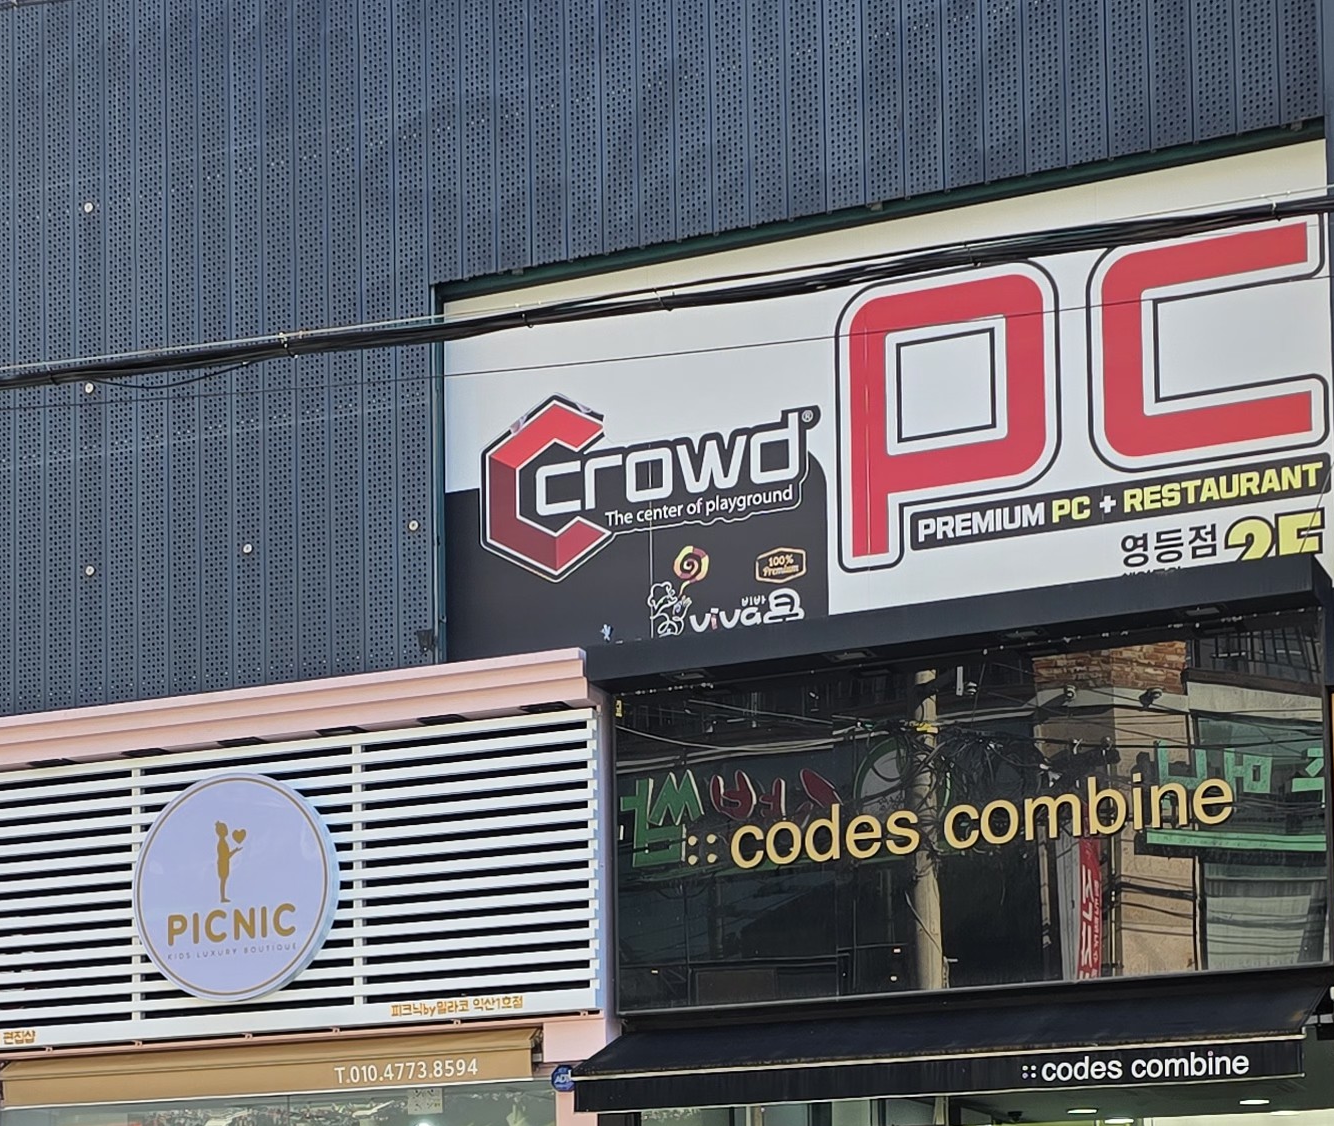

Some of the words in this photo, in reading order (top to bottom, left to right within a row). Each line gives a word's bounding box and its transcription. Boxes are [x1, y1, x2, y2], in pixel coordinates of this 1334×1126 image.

[837, 218, 1323, 568] PC
[605, 510, 633, 527] The
[635, 505, 685, 523] center
[686, 500, 704, 516] of
[705, 484, 794, 513] playground
[917, 501, 1045, 542] PREMIUM
[1051, 494, 1091, 524] PC
[1123, 462, 1324, 513] RESTAURANT
[768, 554, 794, 567] 100%
[1120, 522, 1218, 568] 영등점
[944, 773, 1234, 849] combine
[168, 903, 296, 946] PICNIC
[334, 1058, 479, 1084] T.010.4773.8594
[1130, 1050, 1249, 1078] combine
